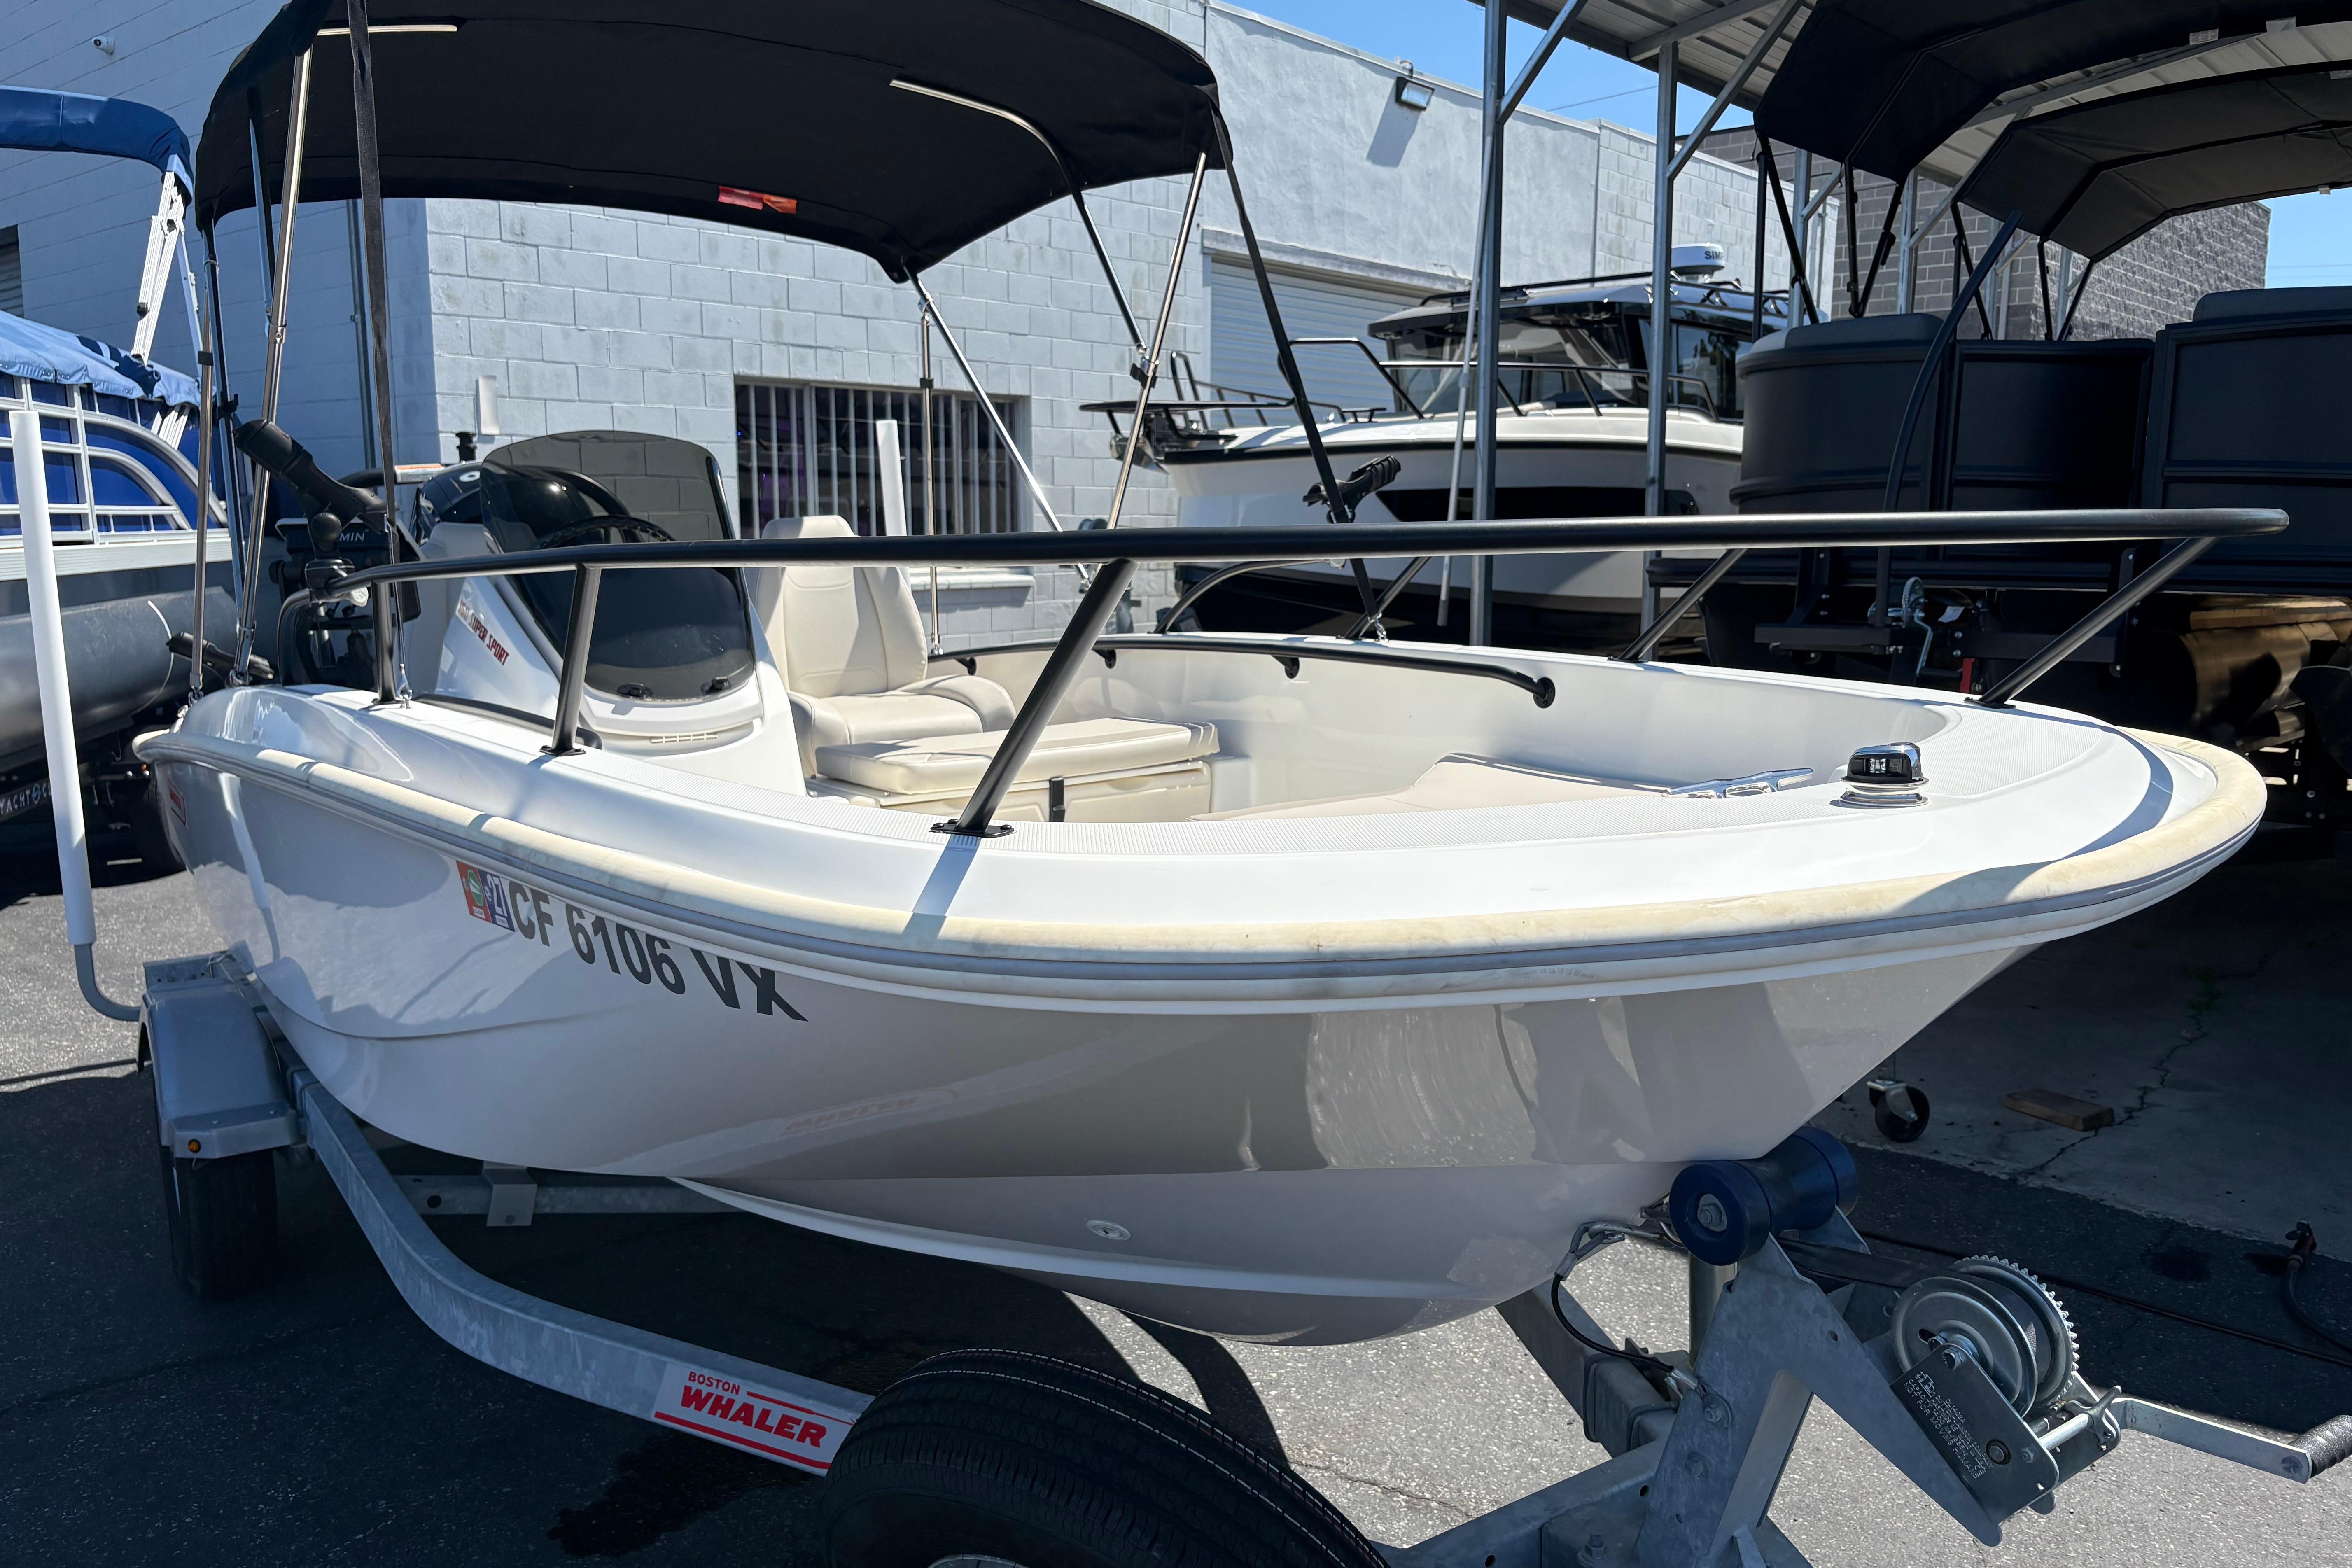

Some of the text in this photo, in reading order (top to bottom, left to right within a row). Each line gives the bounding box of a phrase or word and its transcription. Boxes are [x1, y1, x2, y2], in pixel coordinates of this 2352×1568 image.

[469, 613, 488, 643] SUPER
[486, 634, 509, 665] SPORT
[508, 880, 808, 1021] CF 6106 VX
[688, 1371, 741, 1395] BOSTON
[1908, 1378, 1933, 1409] CAPACITY
[1931, 1409, 1946, 1426] 1400
[681, 1385, 827, 1448] WHALER
[1903, 1381, 1980, 1479] NOT FOR MOVING HUMANS
